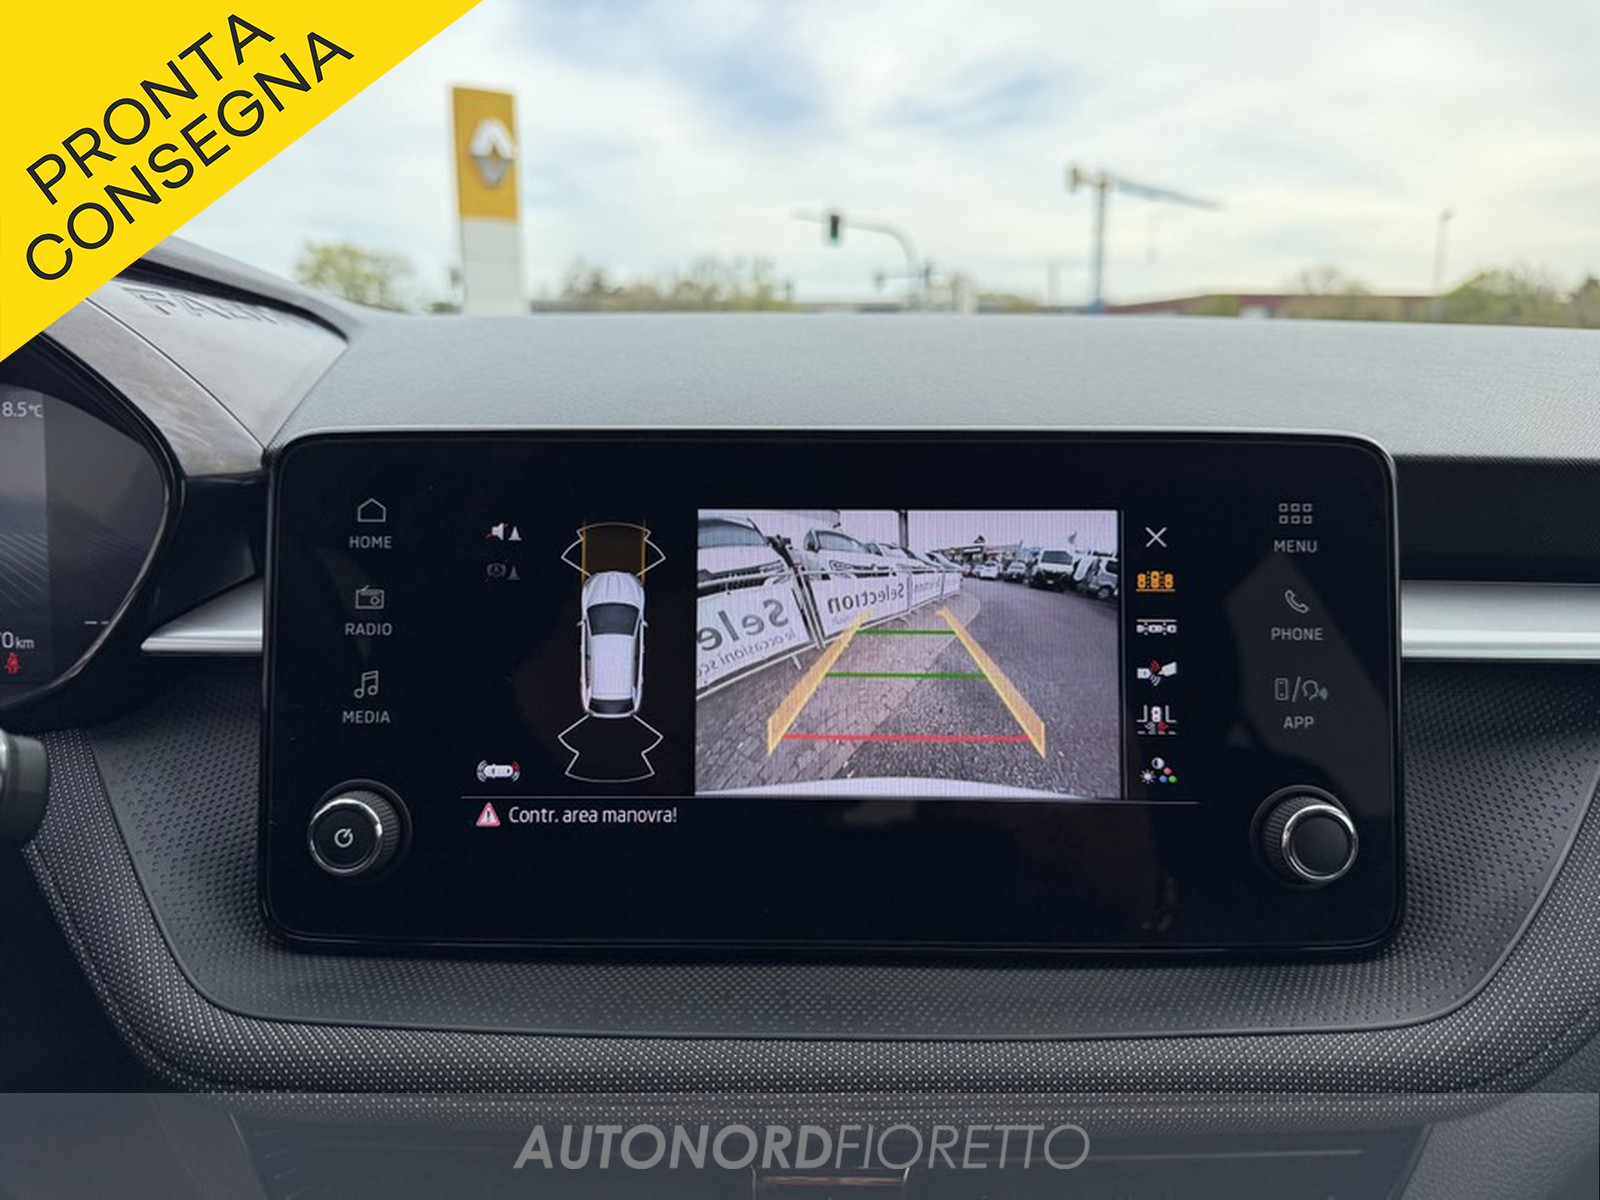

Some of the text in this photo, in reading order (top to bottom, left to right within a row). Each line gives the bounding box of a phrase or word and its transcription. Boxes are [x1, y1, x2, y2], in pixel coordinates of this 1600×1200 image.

[349, 535, 392, 549] HOME
[1273, 540, 1318, 553] MENU
[344, 623, 393, 636] RADIO
[1270, 627, 1323, 641] PHONE
[342, 711, 391, 724] MEDIA
[1283, 716, 1315, 729] APP
[508, 806, 678, 823] Contr. area manovra!
